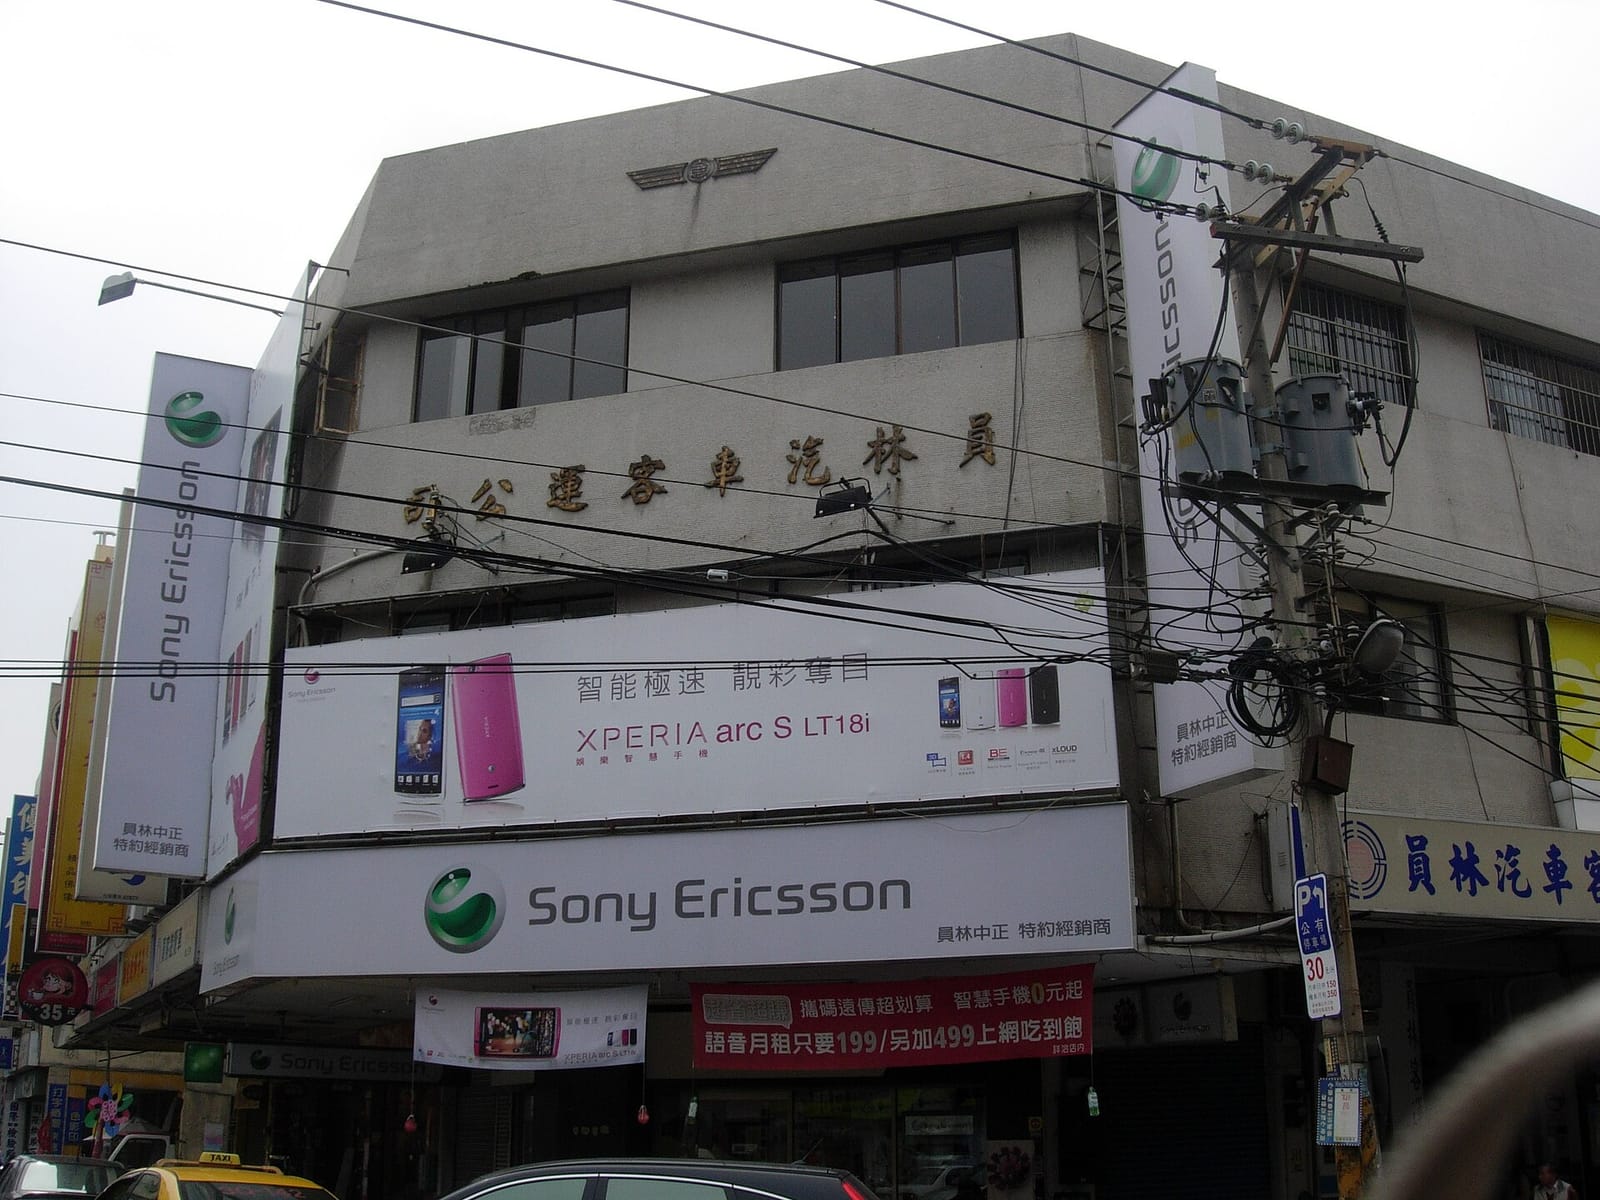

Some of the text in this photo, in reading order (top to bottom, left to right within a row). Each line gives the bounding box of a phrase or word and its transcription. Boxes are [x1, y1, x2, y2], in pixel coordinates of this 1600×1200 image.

[150, 460, 200, 703] Sony Ericsson
[577, 666, 705, 703] 智能極速
[577, 712, 871, 752] XPERIA arc S LT18i
[1177, 709, 1229, 743] 員林中正
[1171, 730, 1237, 767] 特約經銷商
[113, 838, 190, 858] 特約經銷商
[122, 822, 183, 841] 員林中正
[528, 877, 911, 932] Sony Ericsson
[1298, 884, 1311, 917] P
[937, 918, 1111, 943] 員林中正 特約經銷商
[1301, 918, 1324, 936] 公有
[1306, 956, 1325, 982] 30
[40, 1003, 63, 1021] 35
[800, 980, 1083, 1018] 攜碼遠傳超划算 智慧手機0元起
[705, 1016, 1083, 1055] 語音月租只要199/另加499上網吃到飽
[280, 1053, 333, 1074] Sony
[210, 1154, 231, 1162] TAXI
